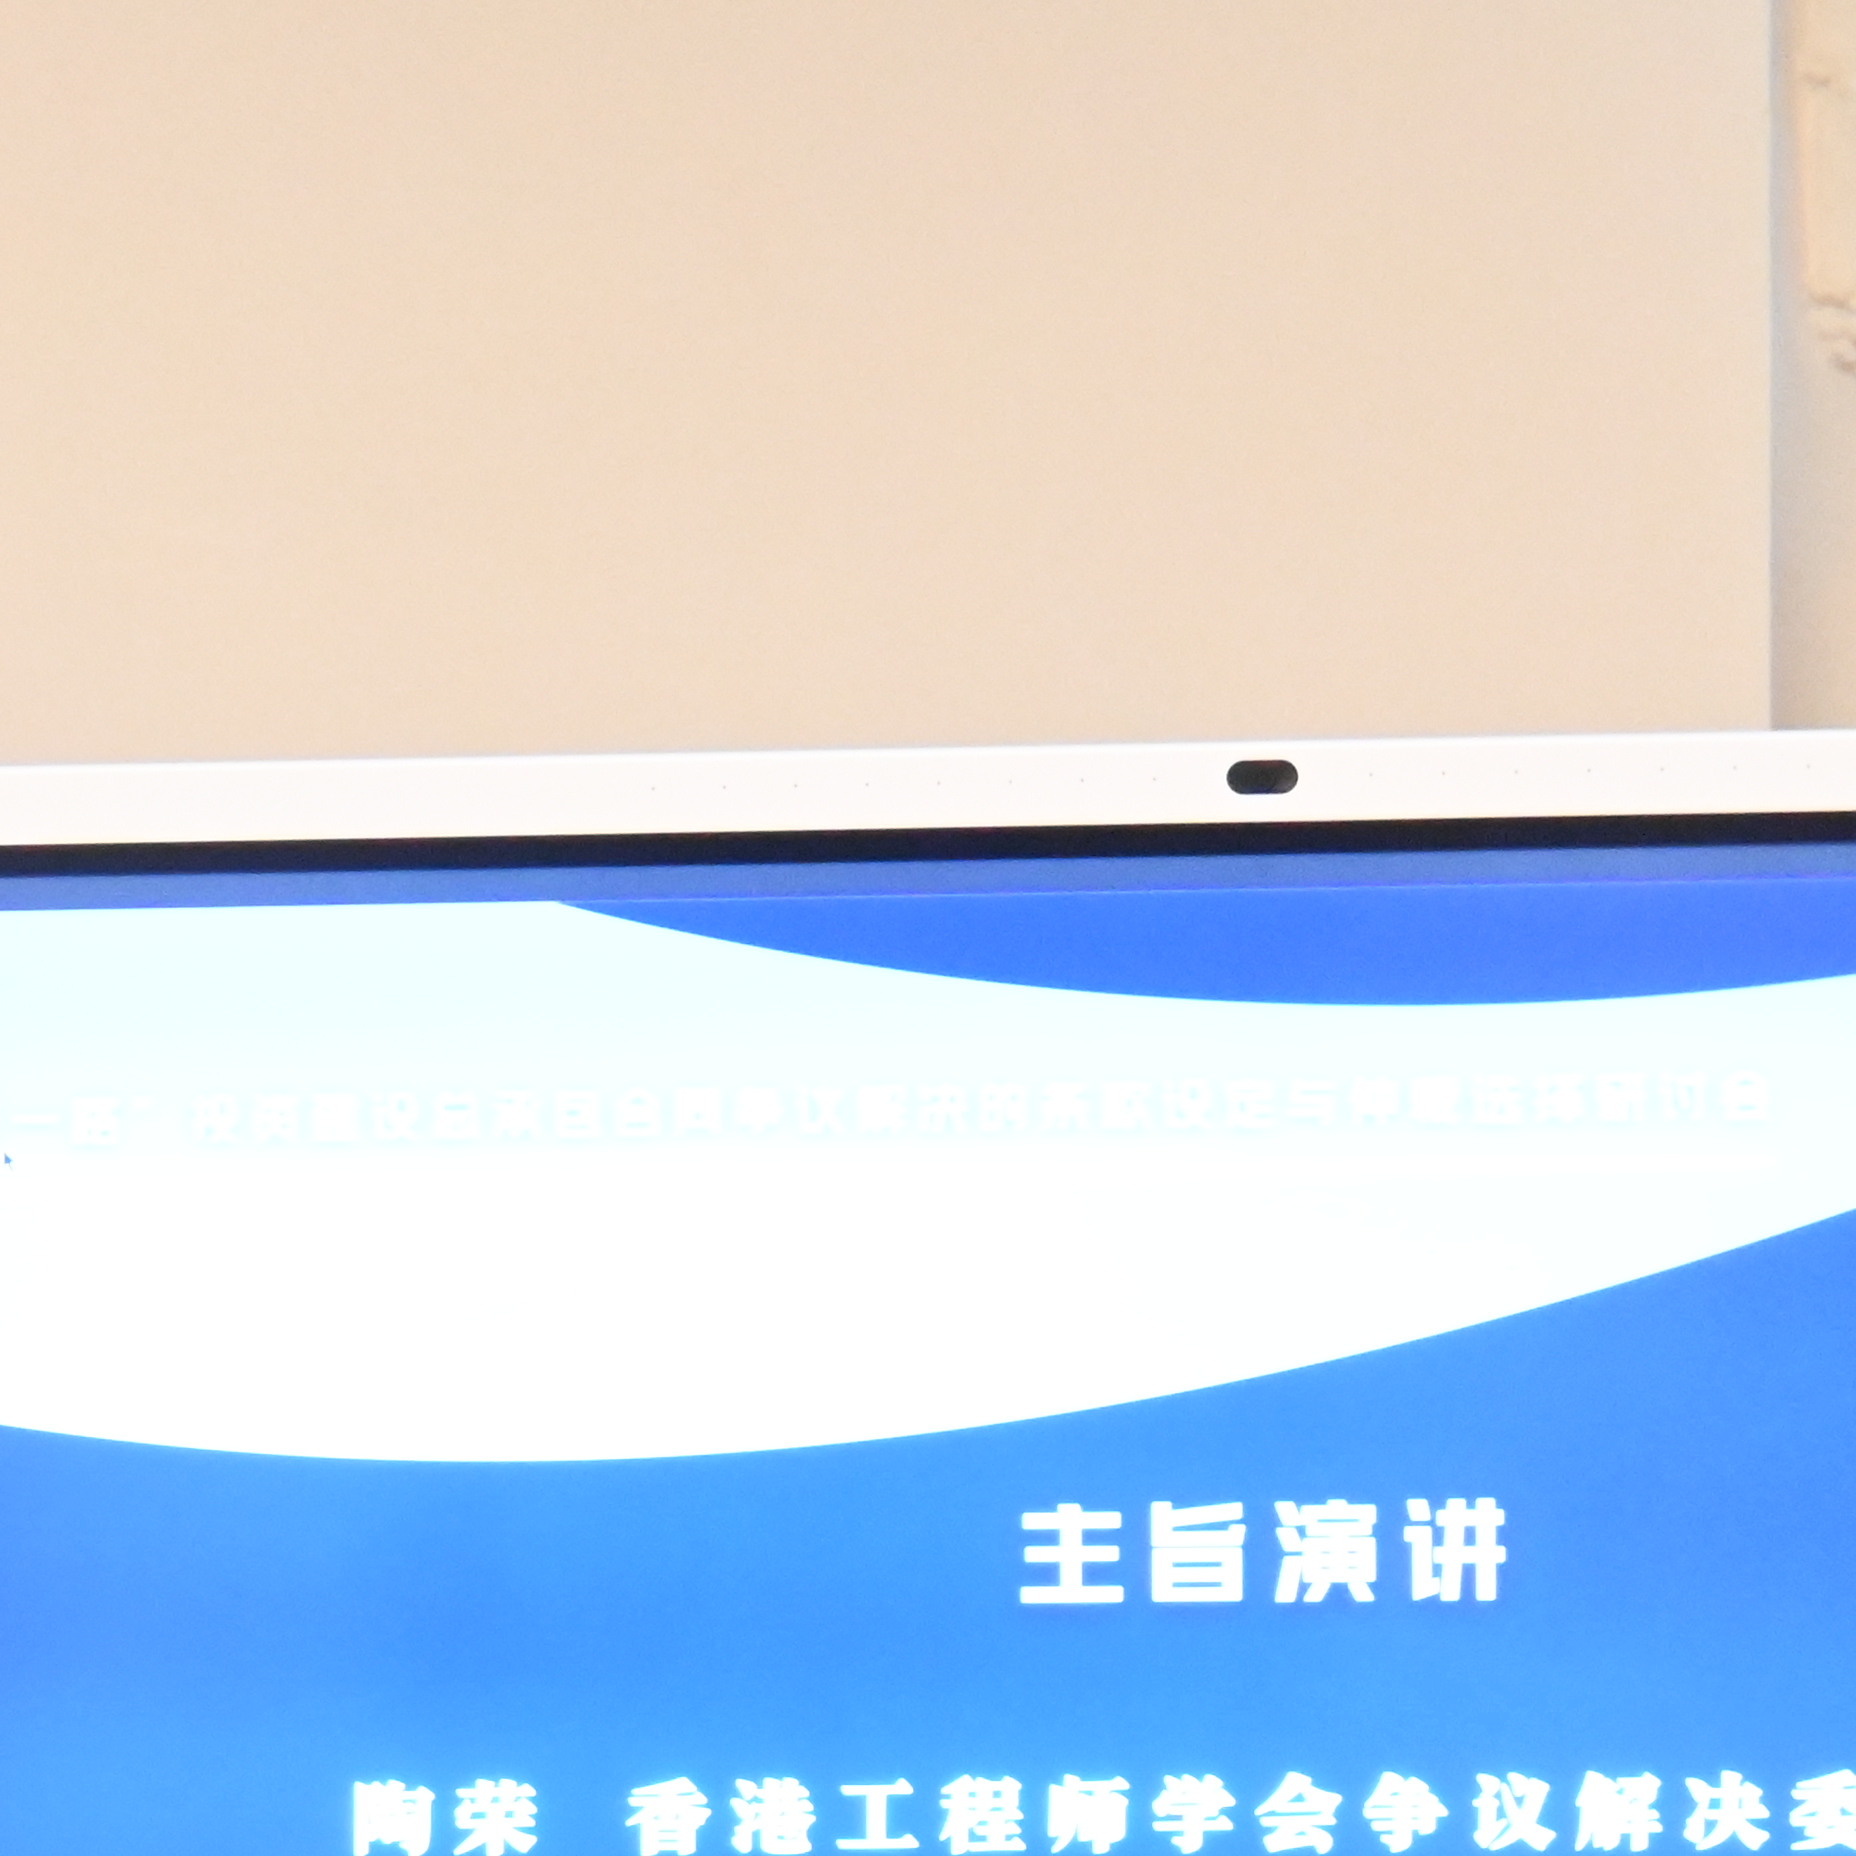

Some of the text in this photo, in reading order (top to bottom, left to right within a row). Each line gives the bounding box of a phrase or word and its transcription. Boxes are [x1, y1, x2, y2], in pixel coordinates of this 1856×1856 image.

[1021, 1498, 1506, 1603] 主旨演讲
[626, 1770, 1856, 1856] 香港工程师学会争议解决委
